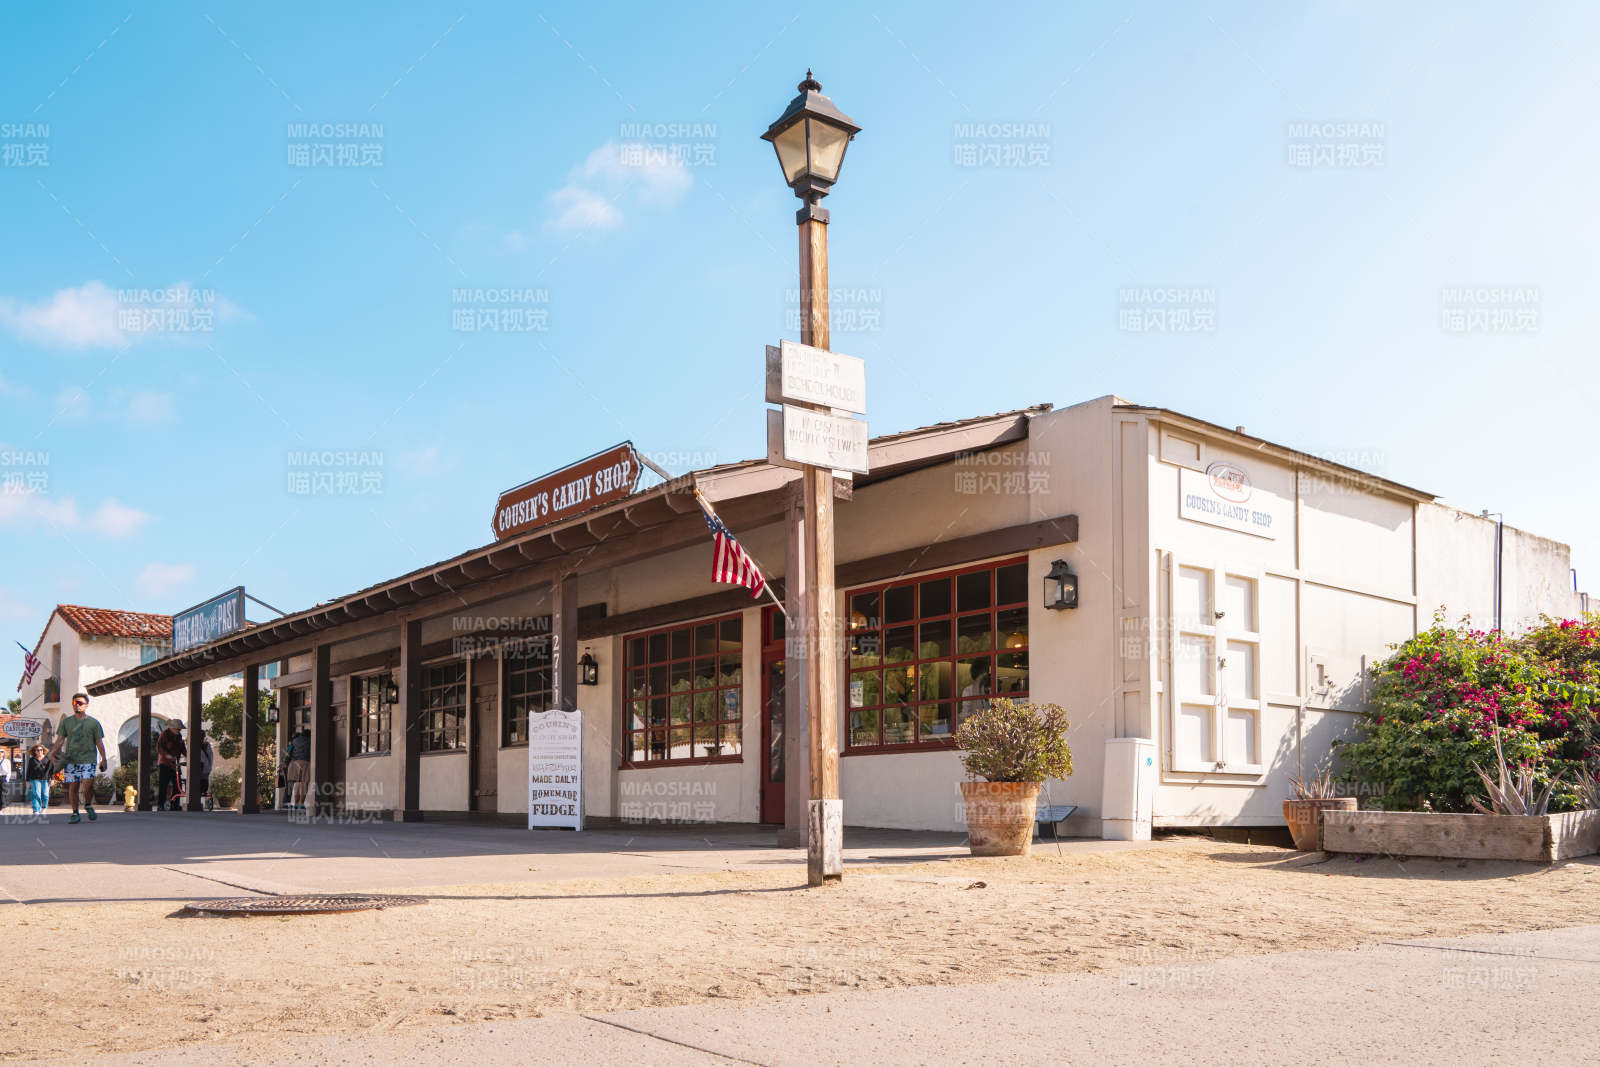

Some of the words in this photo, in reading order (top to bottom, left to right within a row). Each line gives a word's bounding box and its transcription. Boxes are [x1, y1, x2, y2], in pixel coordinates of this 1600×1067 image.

[498, 492, 549, 532] COUSIN'S
[552, 474, 593, 512] CANDY
[1222, 504, 1249, 522] CANDY
[1251, 511, 1272, 528] SHOP
[175, 613, 204, 652] THREADS
[552, 634, 560, 705] 2711
[532, 775, 553, 784] MADE
[555, 775, 578, 784] DAILY!
[532, 789, 578, 802] HOMEMADE
